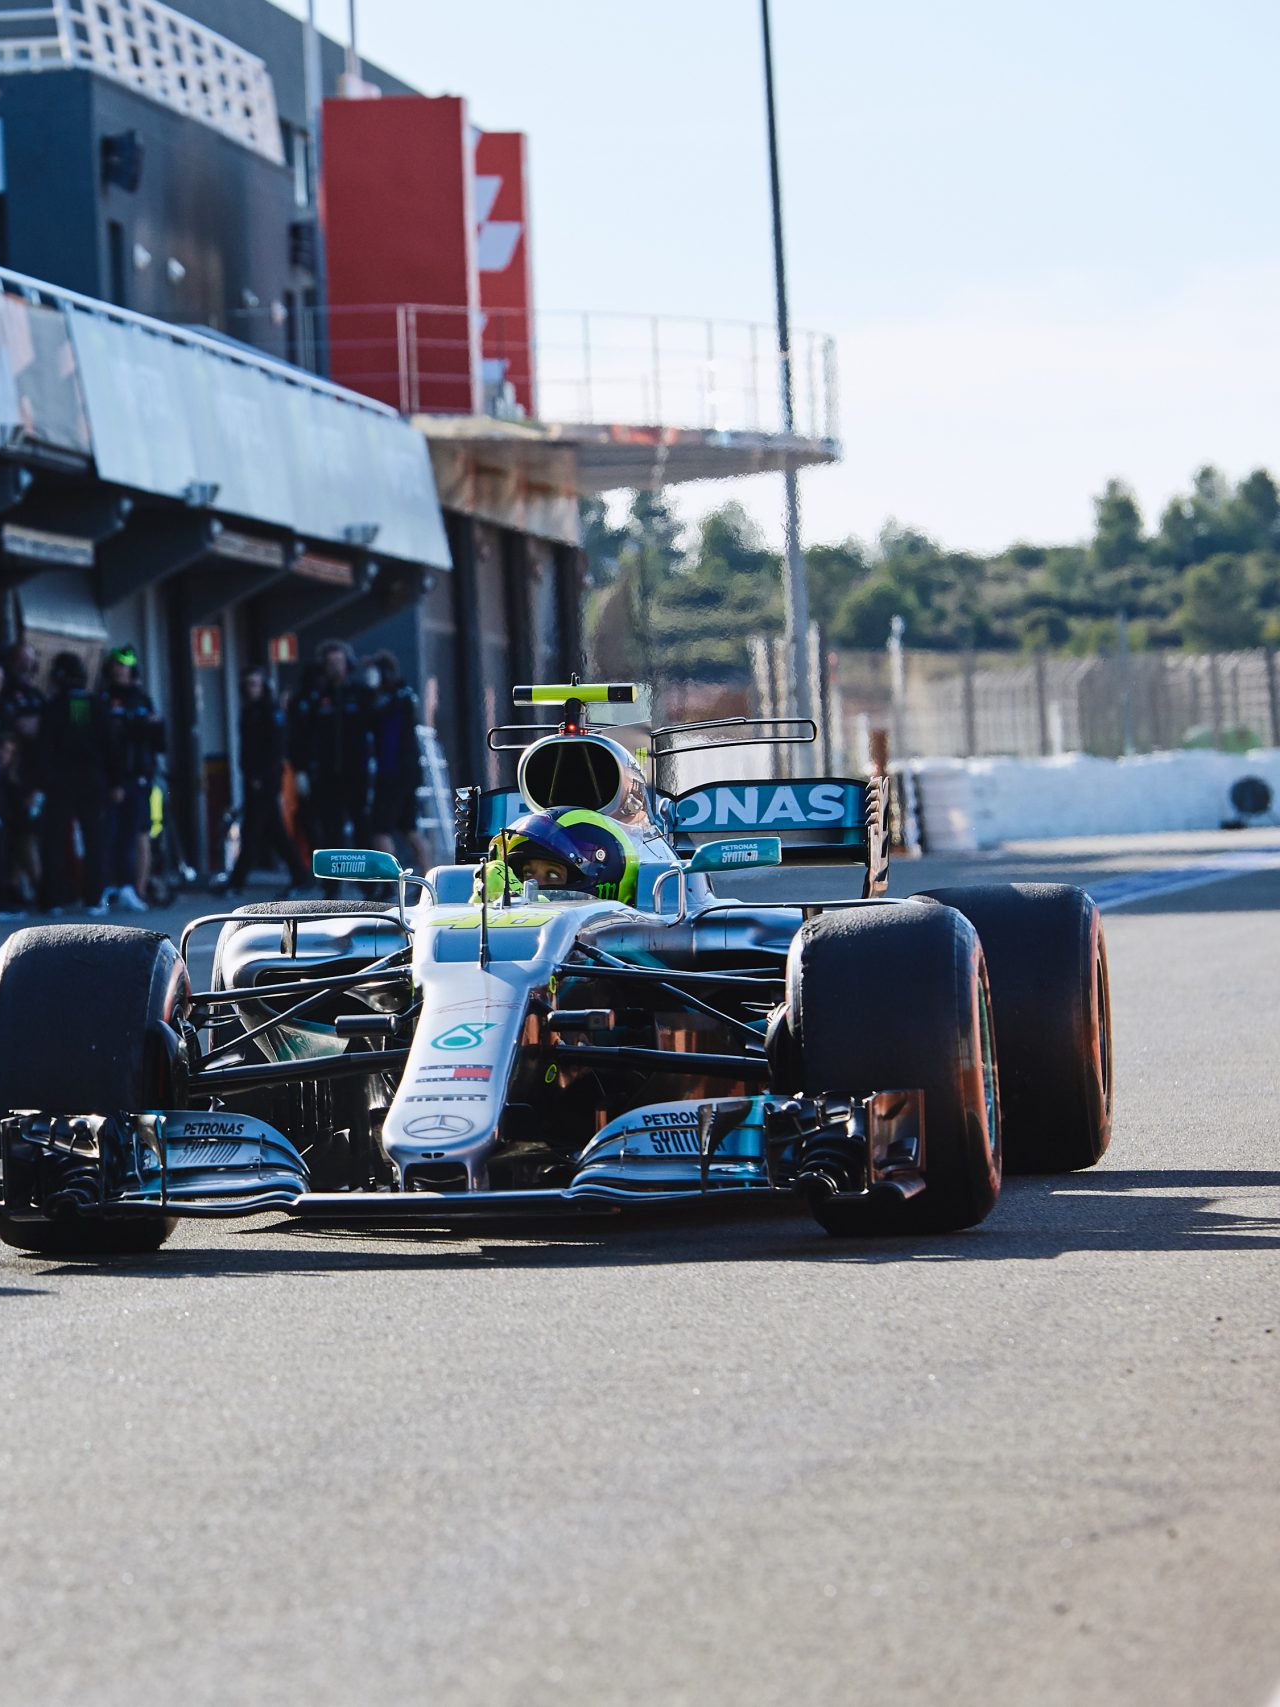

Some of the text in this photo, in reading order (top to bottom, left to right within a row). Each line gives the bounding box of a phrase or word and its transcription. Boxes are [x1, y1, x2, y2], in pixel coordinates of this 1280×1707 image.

[721, 843, 758, 851] PETRONAS
[405, 1094, 488, 1103] PIRELLI
[183, 1122, 245, 1136] PETRONAS
